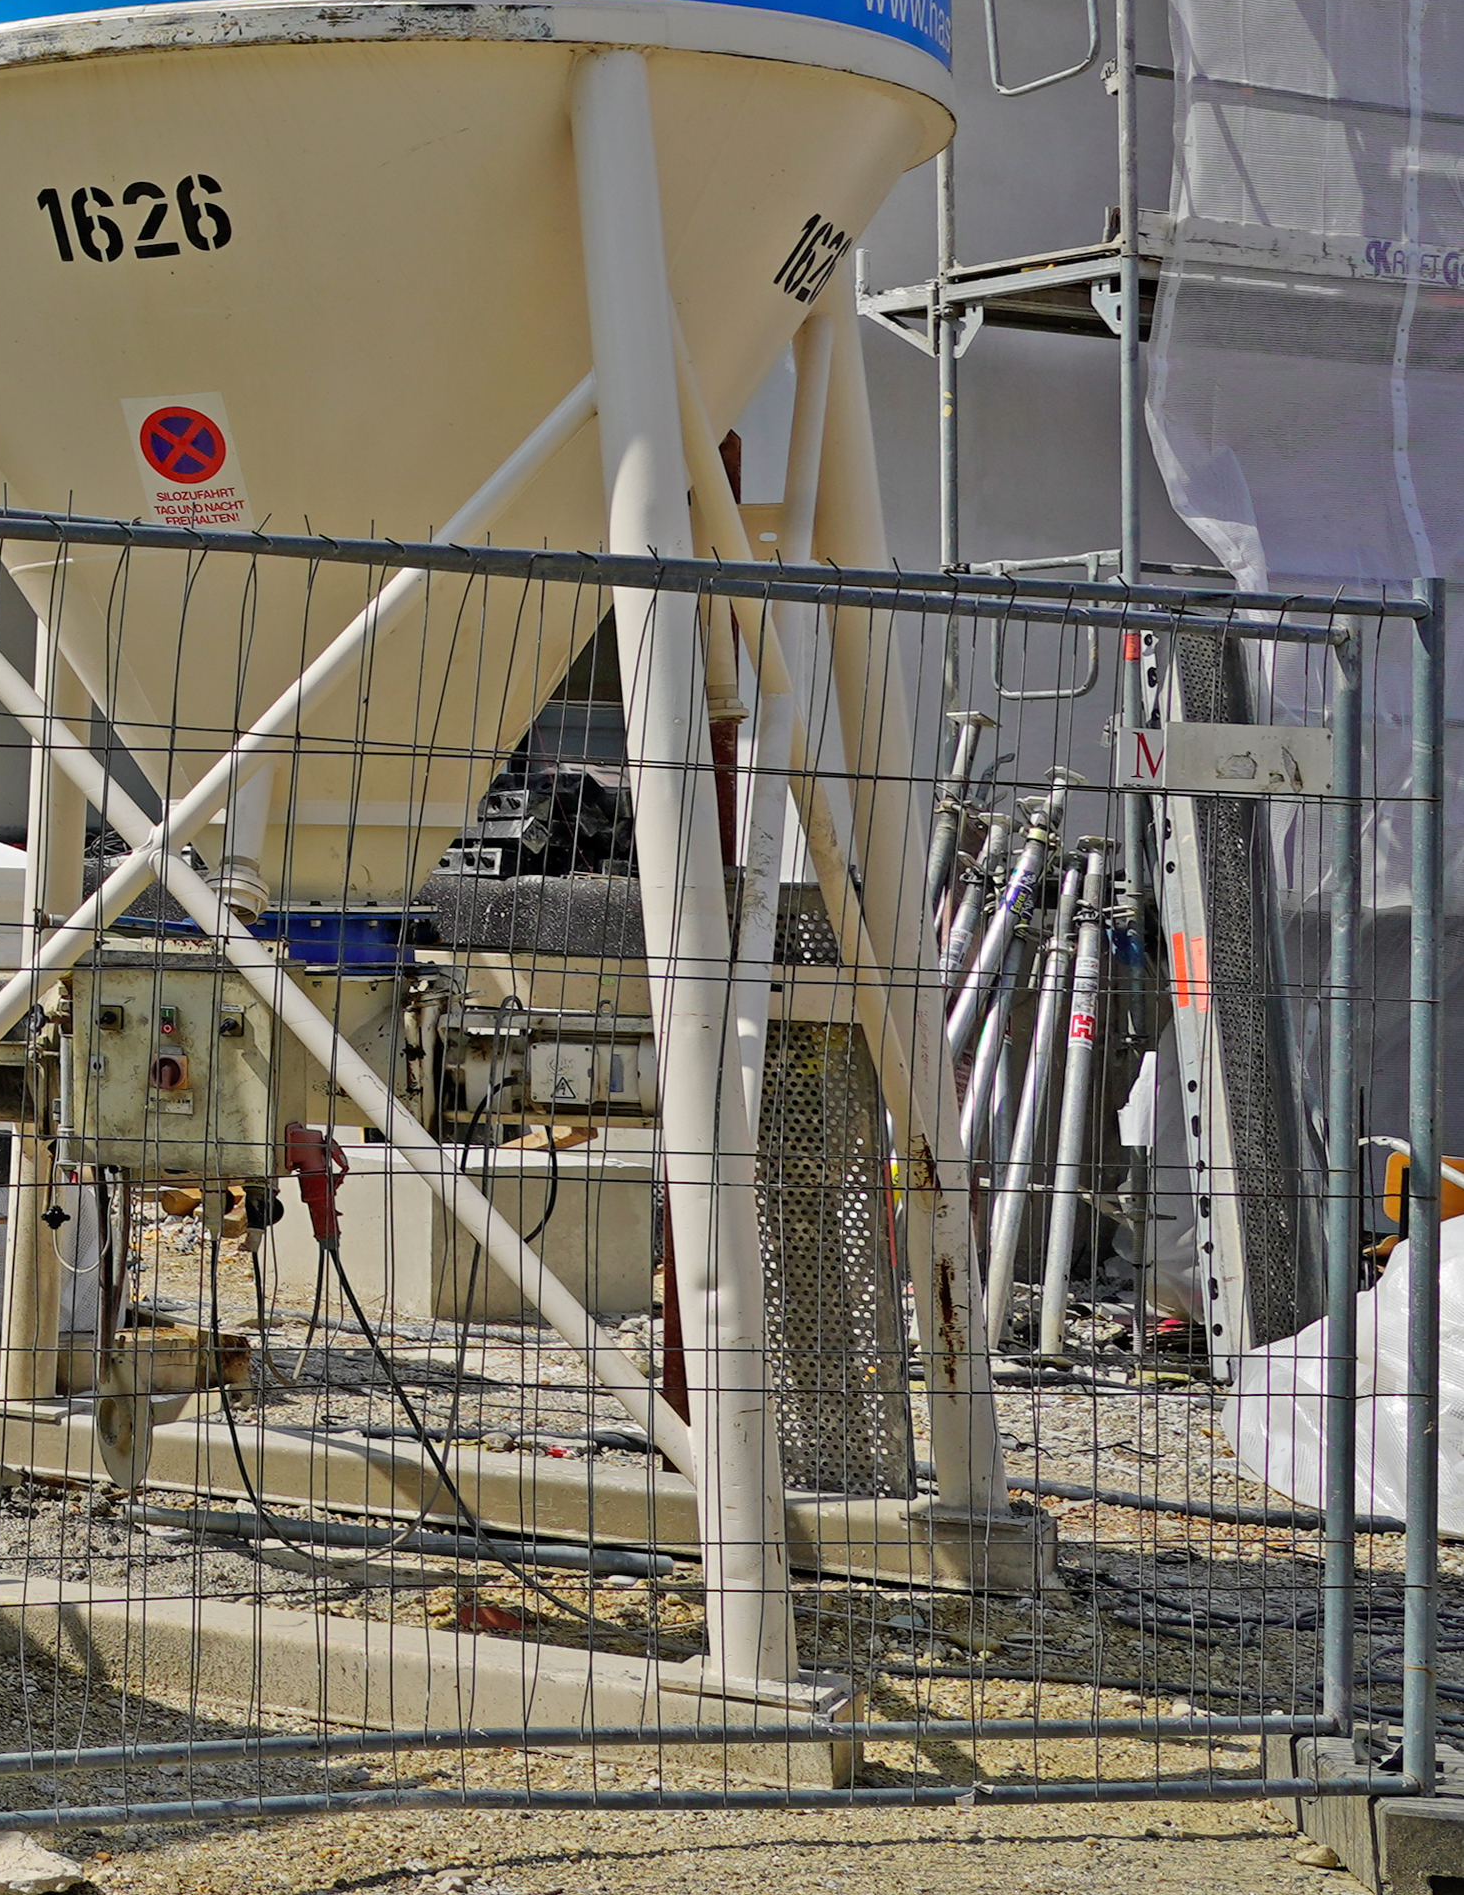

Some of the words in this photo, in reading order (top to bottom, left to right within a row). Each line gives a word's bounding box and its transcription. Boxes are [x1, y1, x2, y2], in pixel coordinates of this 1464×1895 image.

[36, 173, 233, 264] 1626
[156, 487, 235, 502] SILOZUFAHRT
[154, 505, 177, 515] TAG
[177, 503, 203, 515] UND
[204, 500, 245, 512] NACHT
